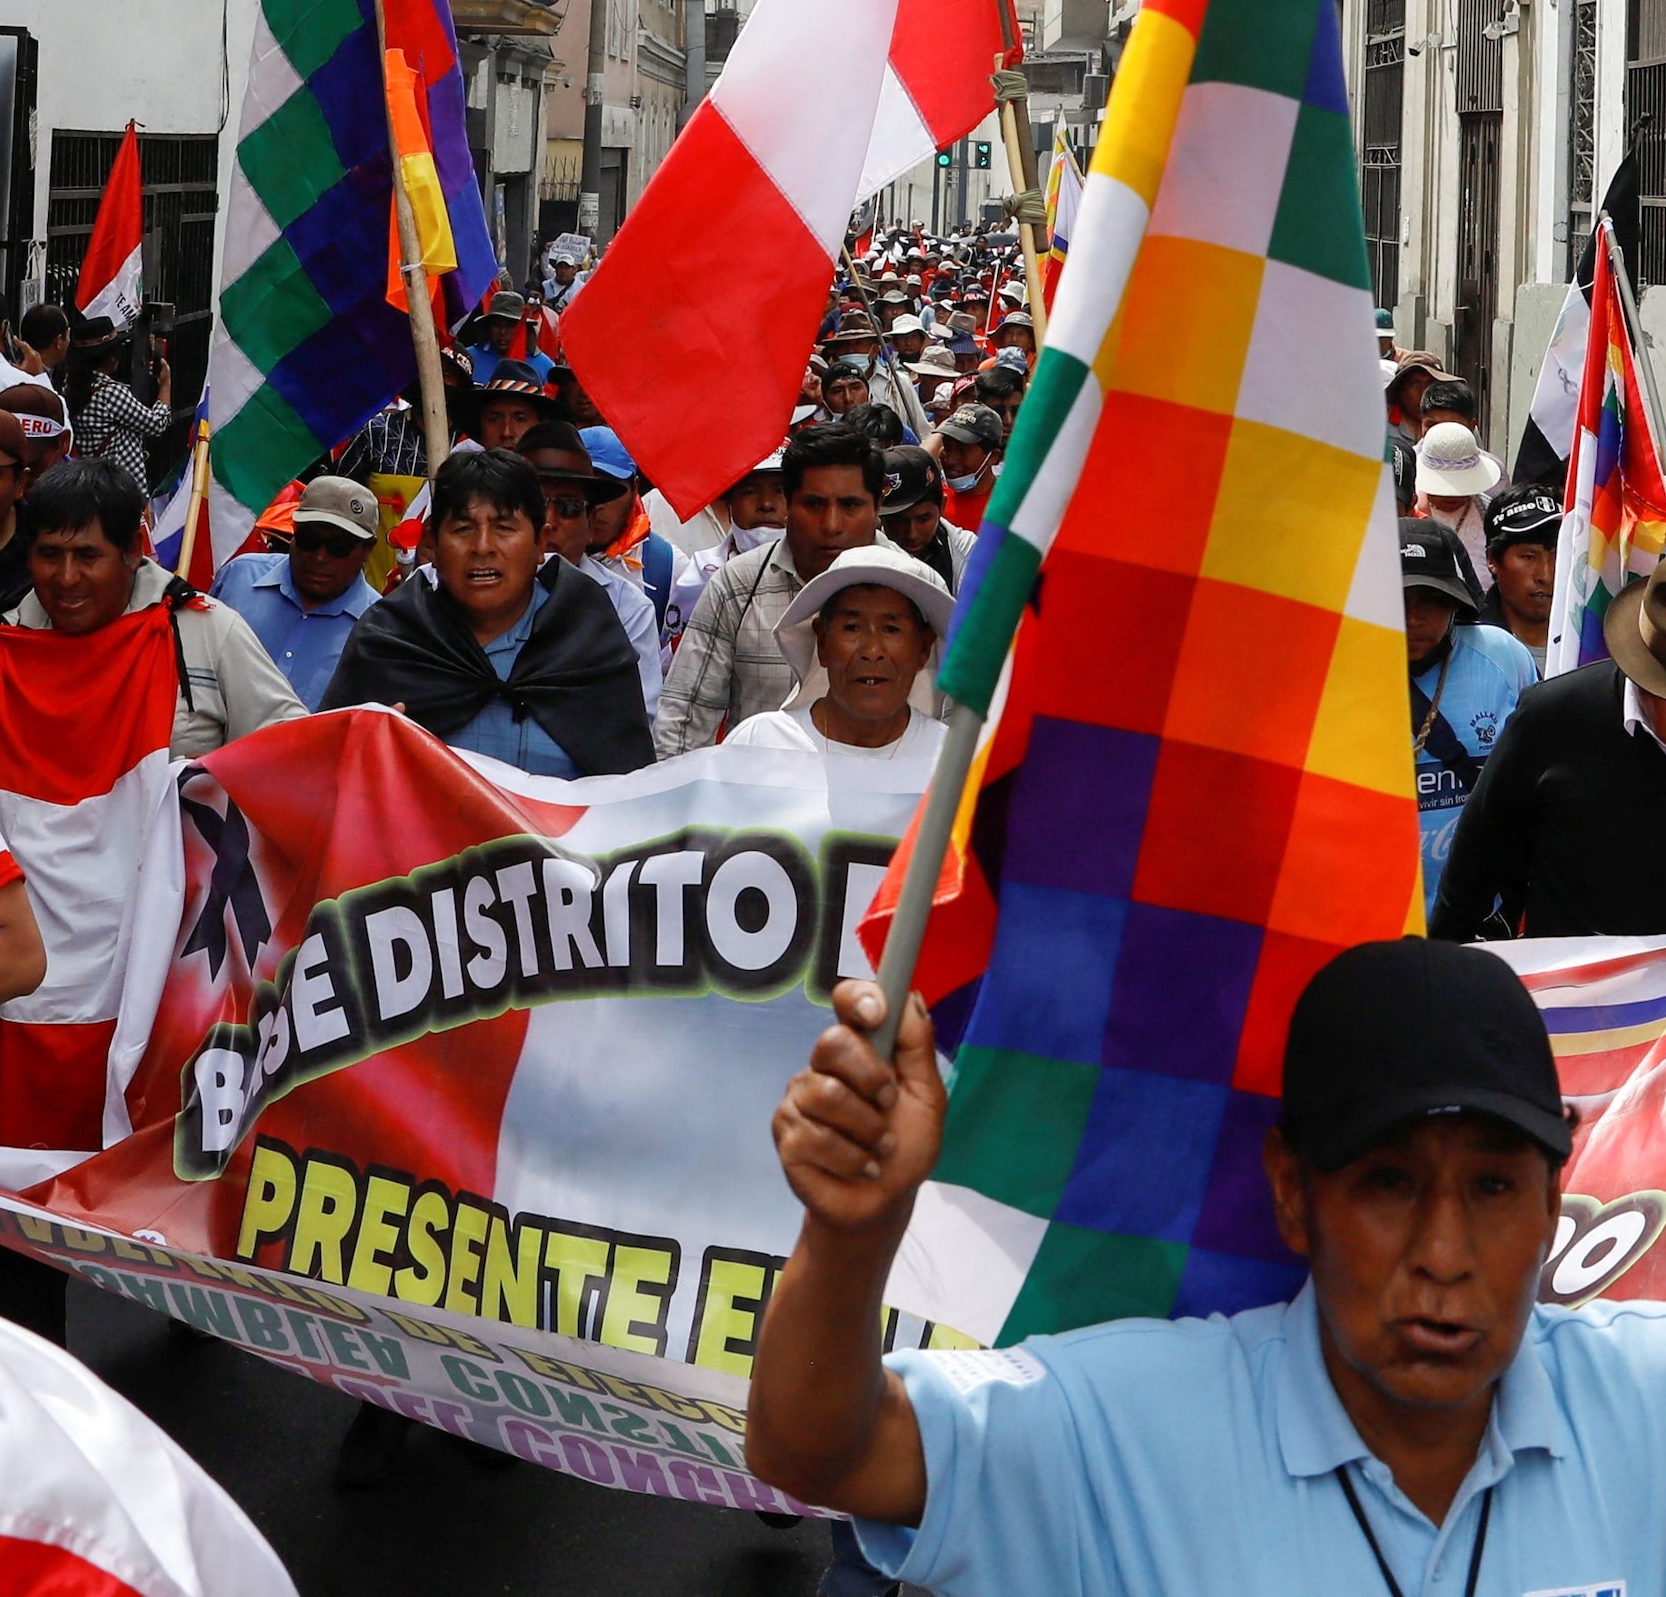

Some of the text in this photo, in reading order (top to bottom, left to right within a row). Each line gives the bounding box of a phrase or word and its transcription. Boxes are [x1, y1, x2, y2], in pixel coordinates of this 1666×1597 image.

[21, 418, 53, 435] ERÚ
[365, 850, 798, 1020] DISTRITO
[238, 1147, 781, 1380] PRESENTE E
